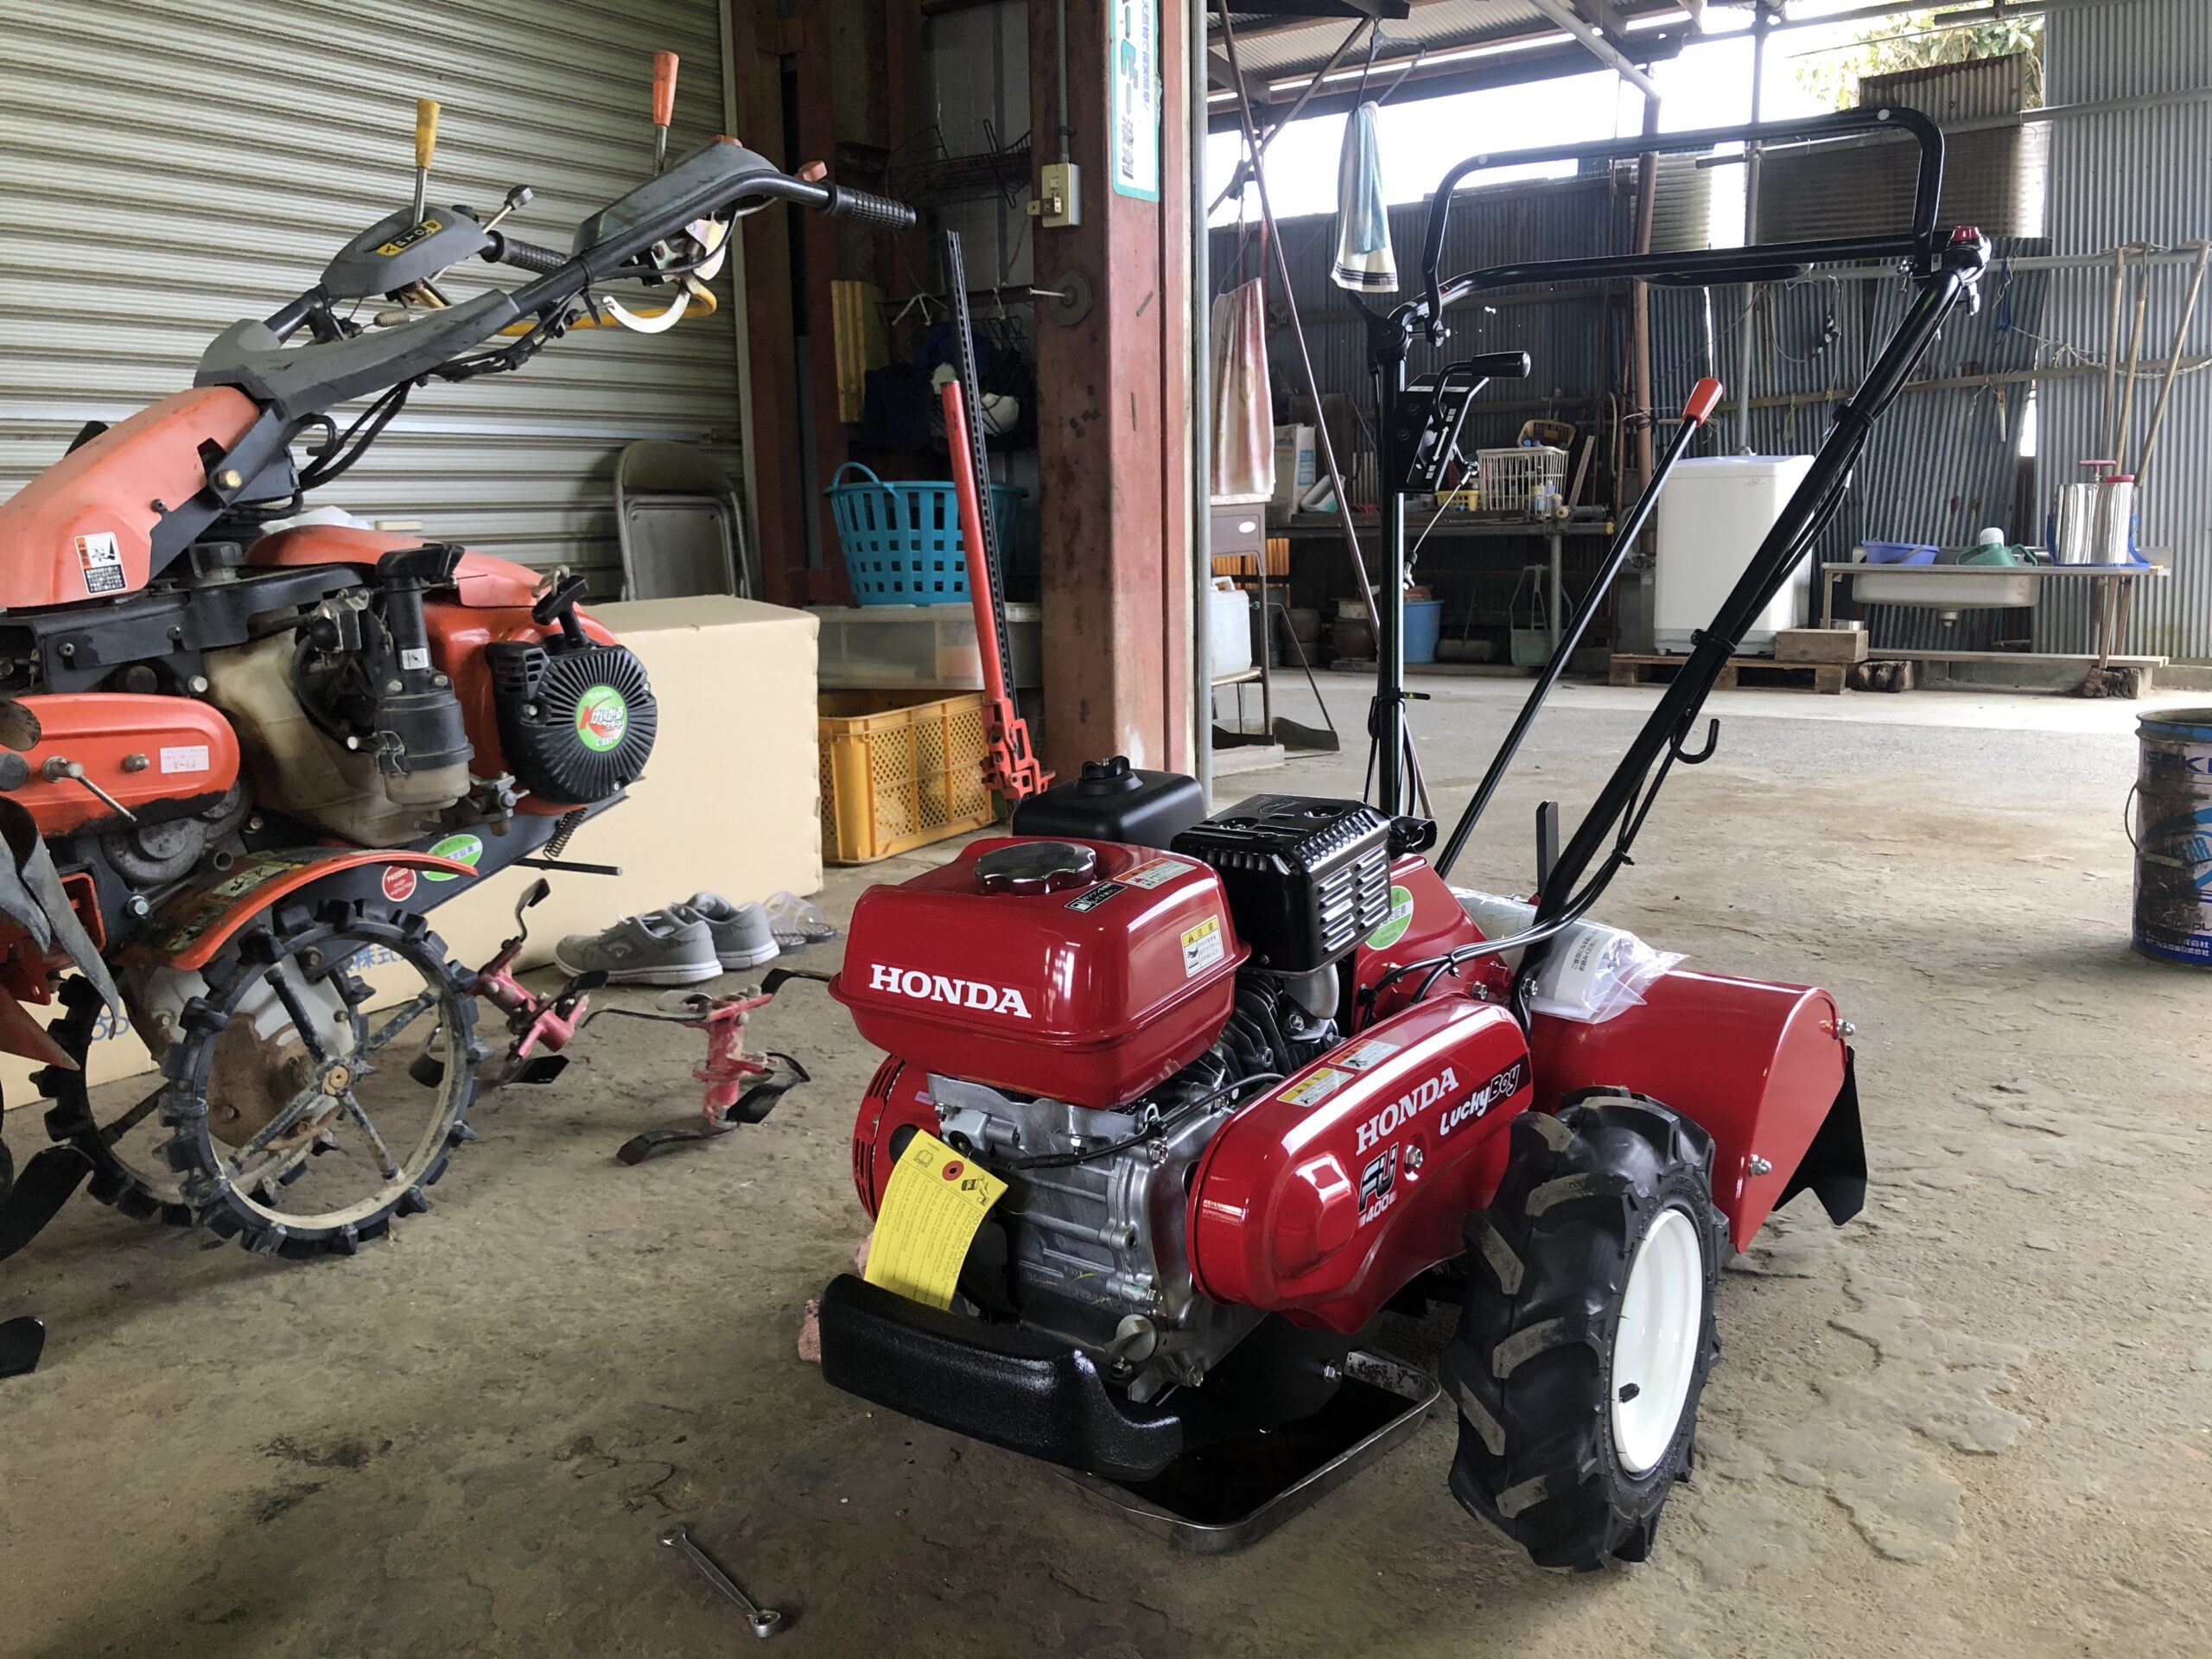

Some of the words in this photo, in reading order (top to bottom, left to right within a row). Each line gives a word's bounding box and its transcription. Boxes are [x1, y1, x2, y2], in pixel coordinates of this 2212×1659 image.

[1121, 0, 1138, 180] ービー液剤
[870, 963, 1032, 1019] HONDA
[1356, 1067, 1459, 1156] HONDA
[1364, 1193, 1391, 1224] 400
